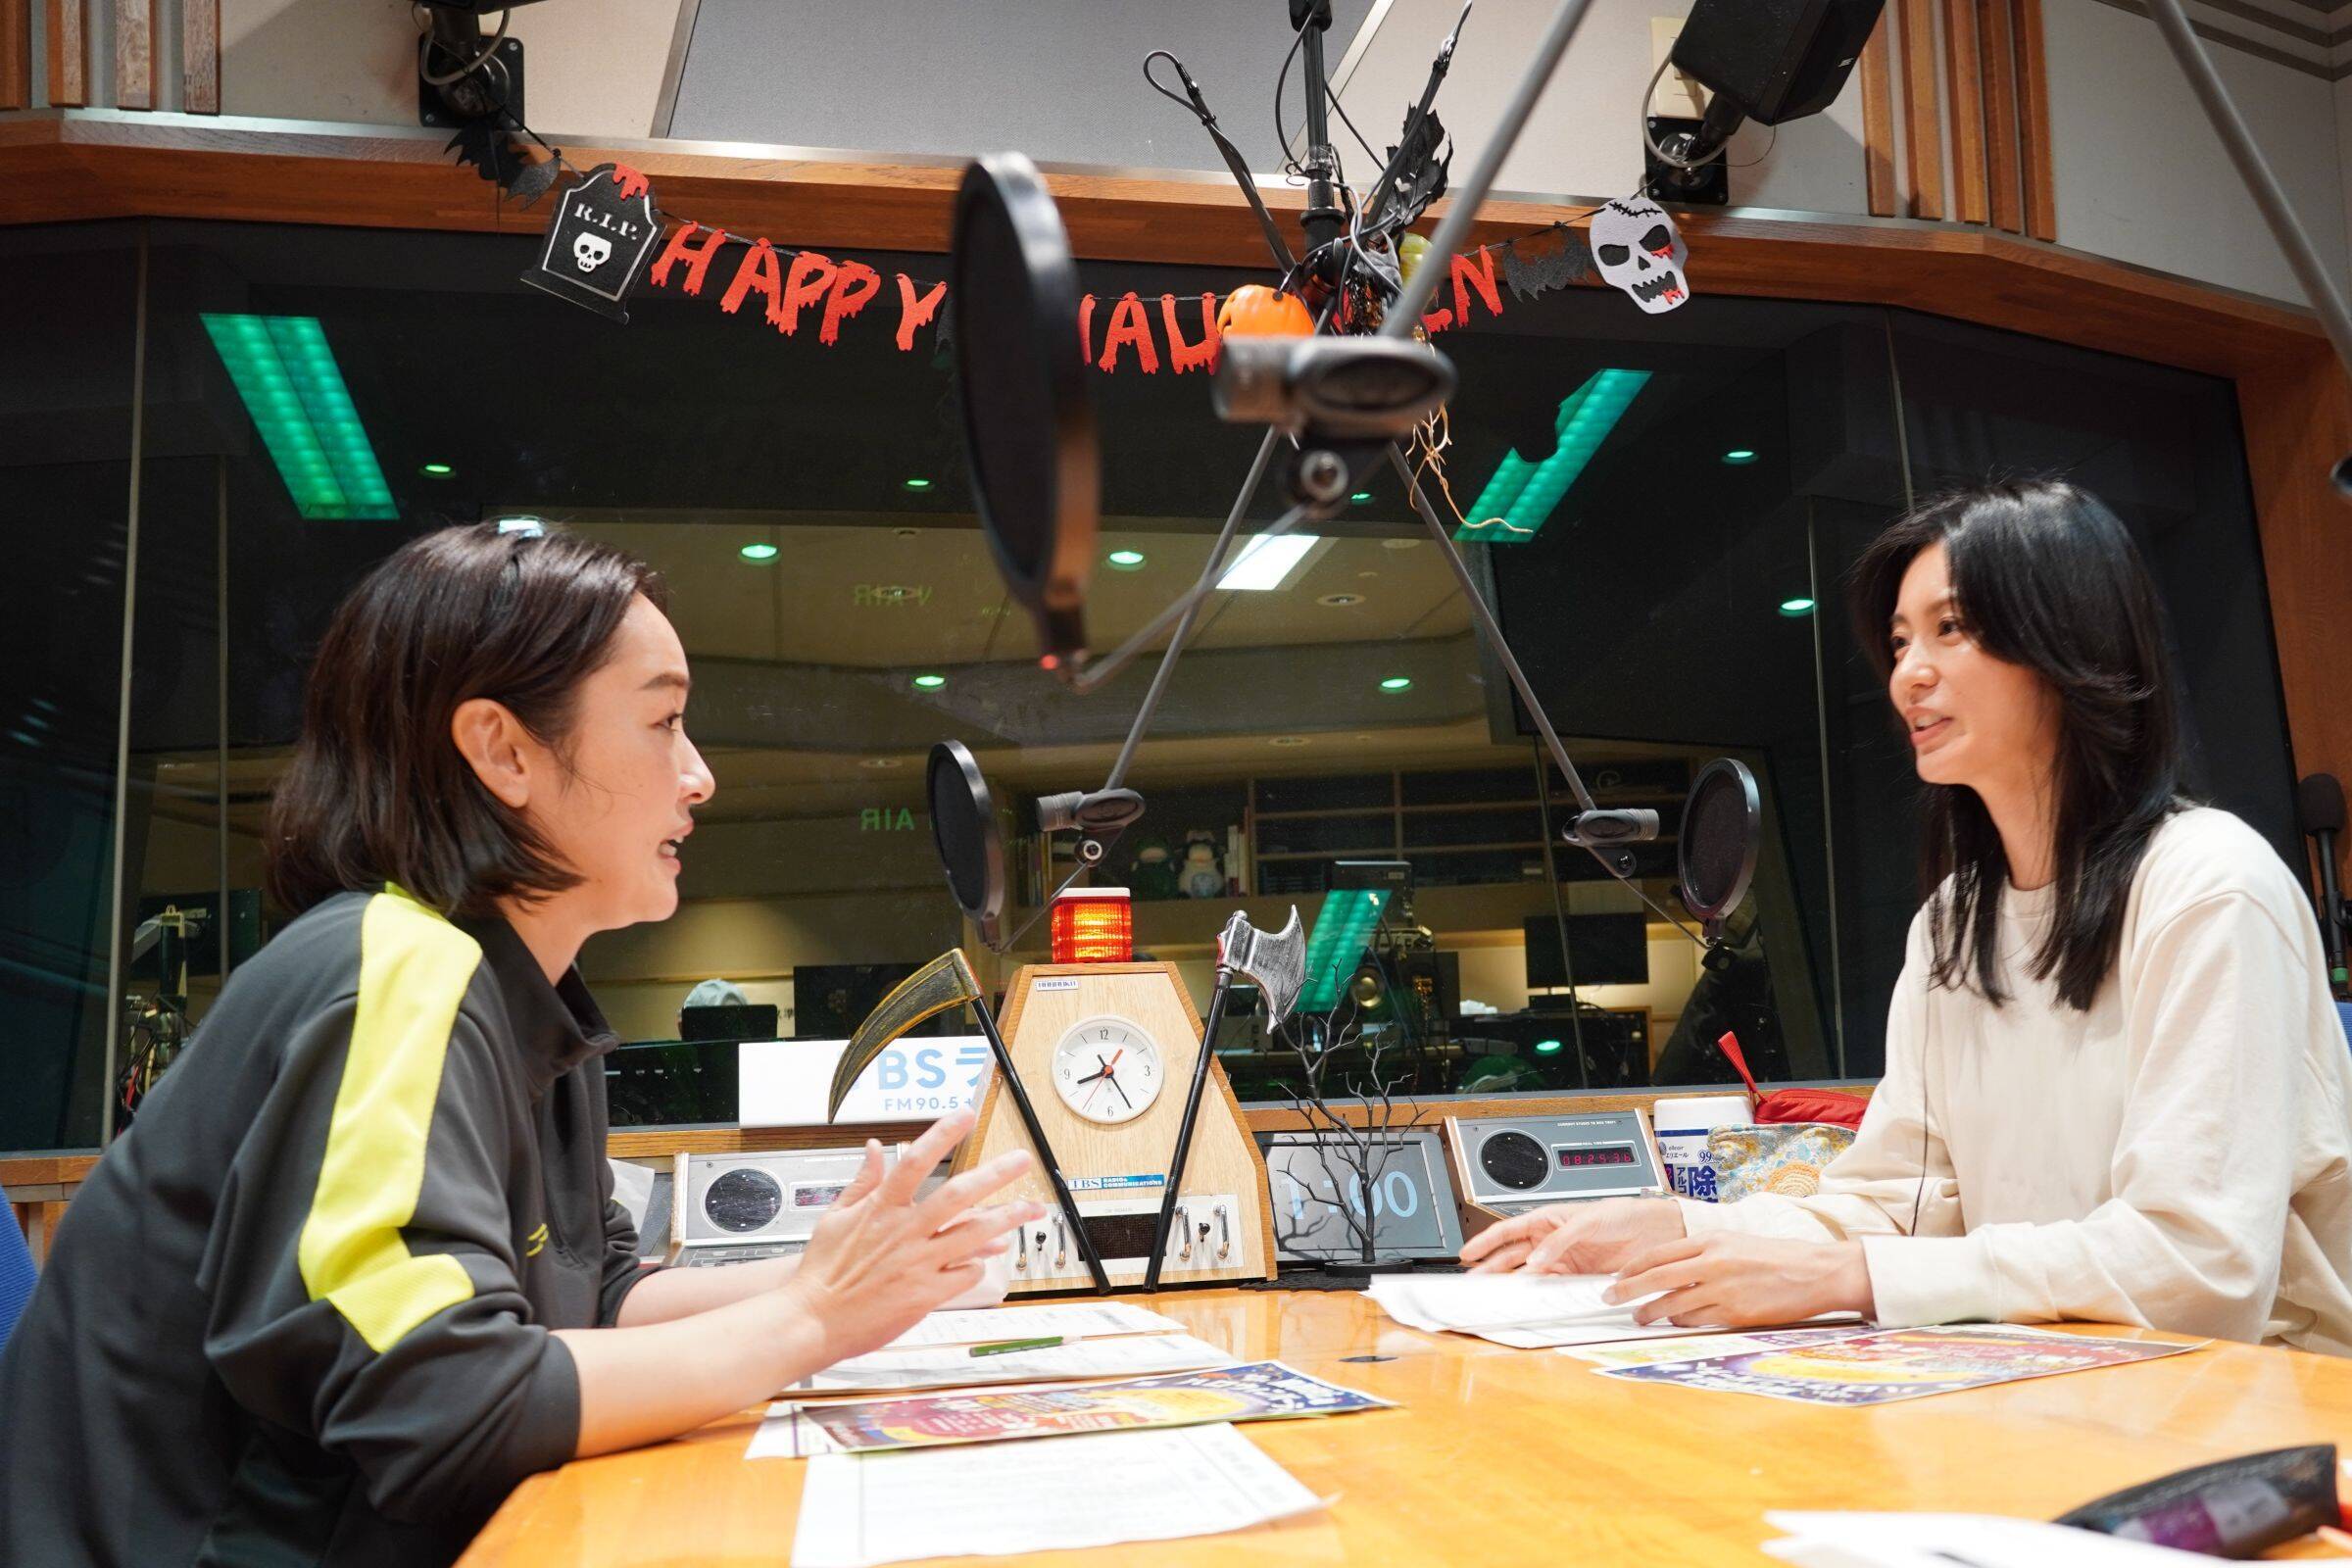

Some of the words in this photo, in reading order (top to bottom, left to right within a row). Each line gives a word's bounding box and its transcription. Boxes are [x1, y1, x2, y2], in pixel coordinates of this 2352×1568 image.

[651, 220, 948, 351] HAPPY
[1100, 1028, 1109, 1040] 12
[1063, 1068, 1070, 1080] 9
[1144, 1064, 1152, 1077] 3
[1106, 1105, 1114, 1117] 6
[1687, 1164, 1719, 1202] 除
